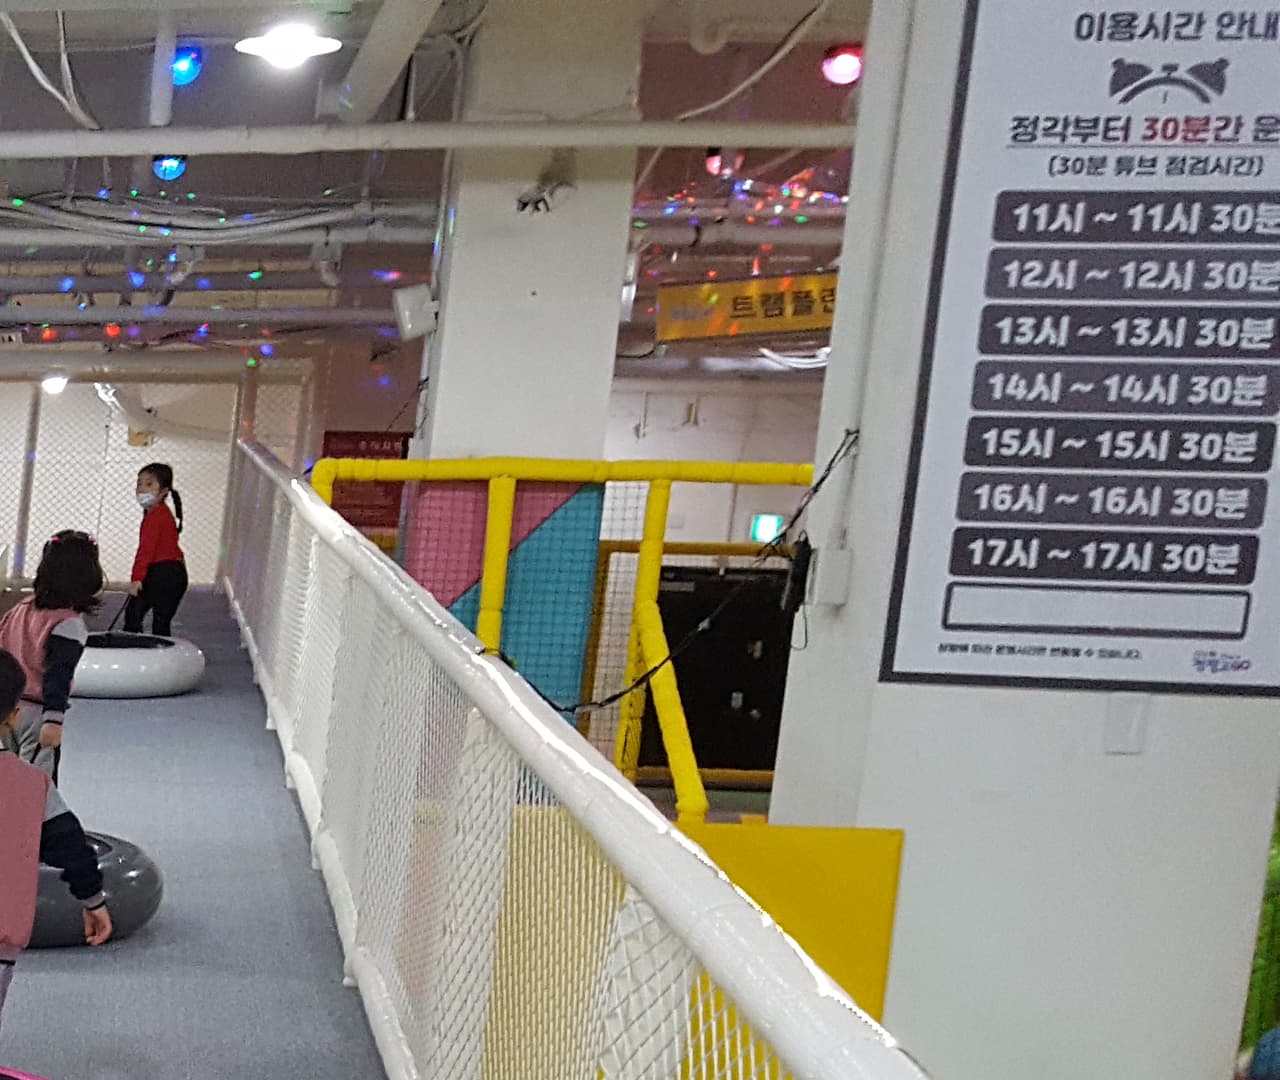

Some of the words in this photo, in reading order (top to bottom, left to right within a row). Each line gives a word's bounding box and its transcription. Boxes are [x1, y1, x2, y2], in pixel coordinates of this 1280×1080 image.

[1075, 12, 1204, 42] 이용시간
[1216, 11, 1280, 41] 안내
[1010, 115, 1132, 144] 정각부터
[1142, 116, 1242, 144] 30분간
[1048, 155, 1108, 178] (30분
[1114, 155, 1157, 177] 튜브
[1165, 155, 1264, 178] 점검시간)
[1013, 202, 1085, 233] 11시
[1128, 201, 1202, 236] 11시
[1209, 203, 1280, 236] 30분
[1003, 258, 1078, 290] 12시
[1119, 260, 1195, 292] 12시
[1203, 261, 1280, 293] 30분
[995, 315, 1069, 348] 13시
[1111, 316, 1186, 349] 13시
[1194, 318, 1275, 350] 30분
[987, 371, 1061, 404] 14시
[1103, 372, 1177, 406] 14시
[1186, 373, 1268, 408] 30분
[981, 427, 1054, 460] 15시
[1095, 429, 1169, 462] 15시
[1178, 430, 1259, 464] 30분
[973, 482, 1047, 515] 16시
[1087, 486, 1161, 517] 16시
[1170, 486, 1251, 520] 30분
[967, 537, 1040, 570] 17시
[1080, 541, 1153, 573] 17시
[1161, 542, 1242, 576] 30분
